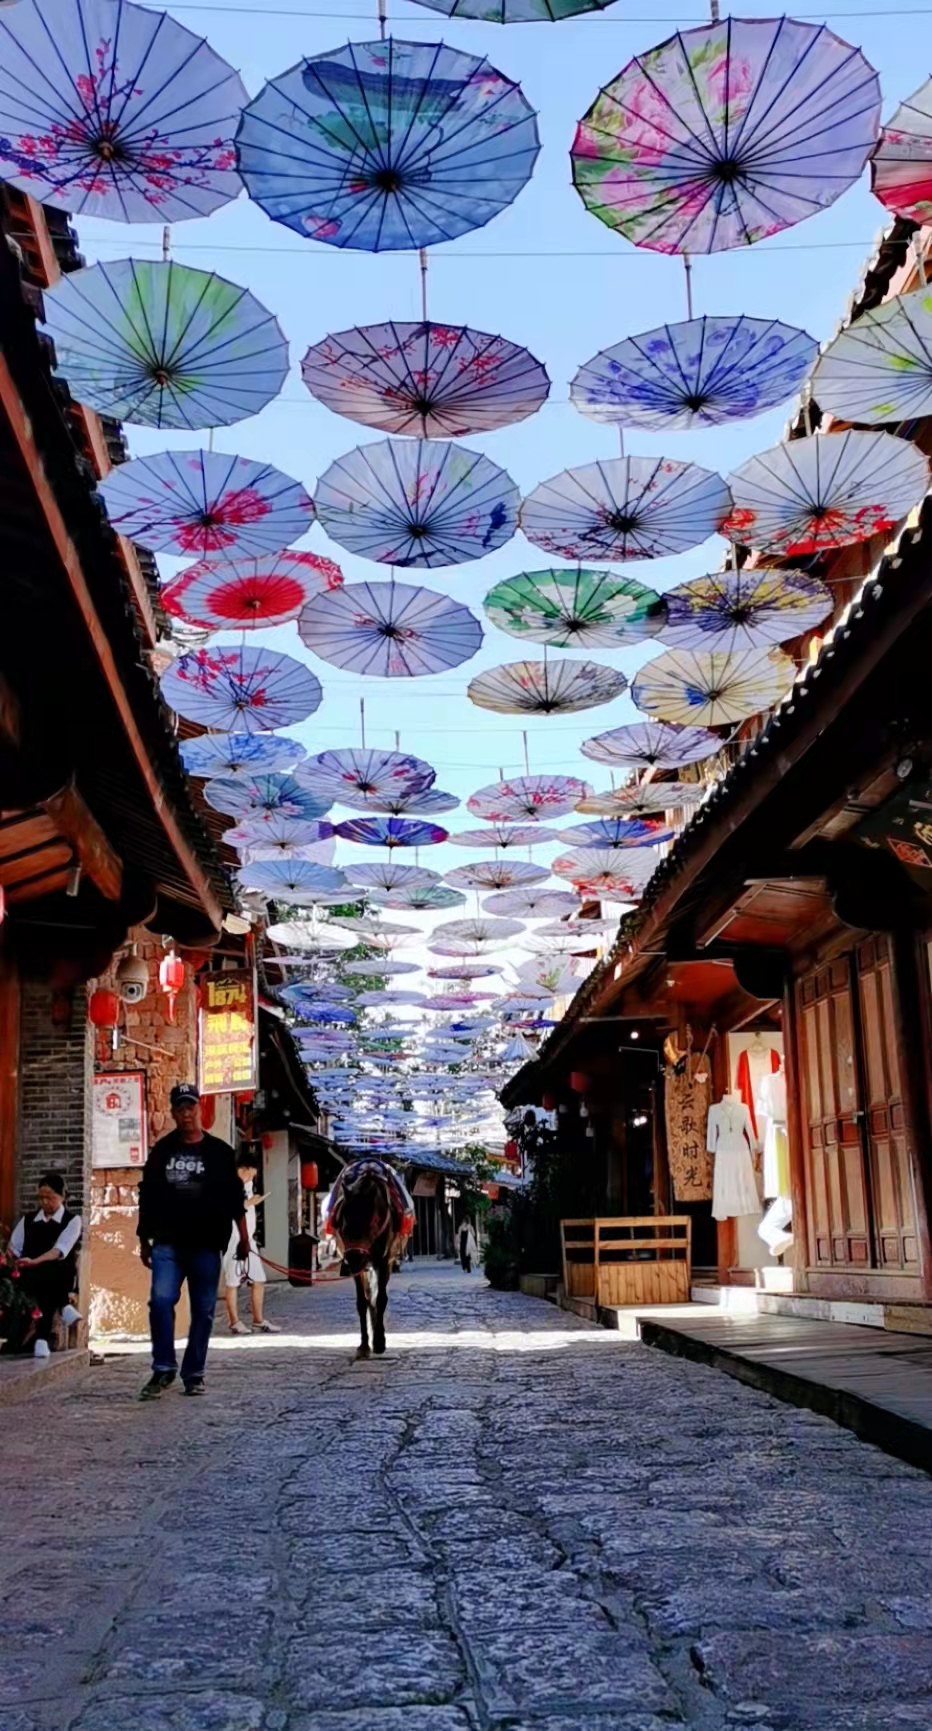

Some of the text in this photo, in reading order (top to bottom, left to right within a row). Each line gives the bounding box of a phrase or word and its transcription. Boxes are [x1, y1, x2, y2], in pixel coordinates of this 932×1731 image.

[207, 982, 247, 1007] 1874
[679, 1093, 702, 1187] 云歌时光
